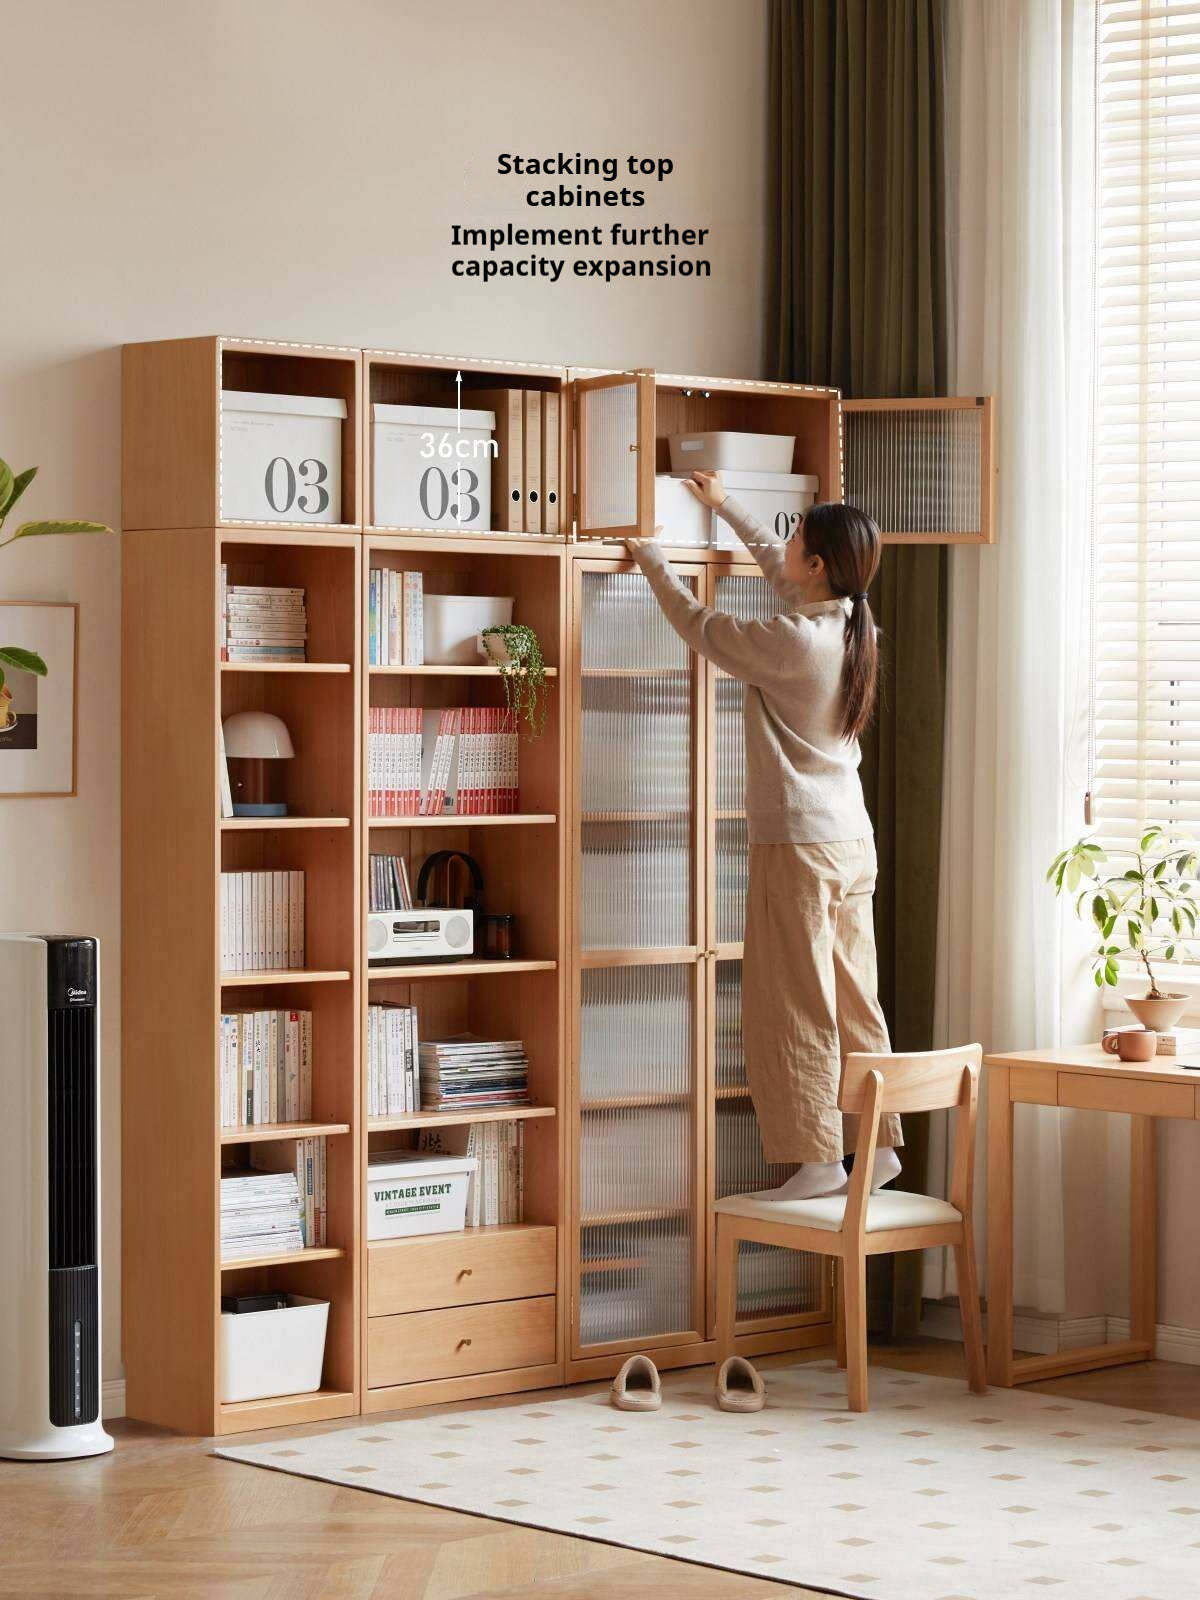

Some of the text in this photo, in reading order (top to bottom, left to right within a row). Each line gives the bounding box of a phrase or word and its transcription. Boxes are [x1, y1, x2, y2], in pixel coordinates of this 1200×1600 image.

[265, 457, 329, 514] 03
[419, 466, 480, 522] 03
[374, 1183, 452, 1202] VINTAGE EVENT
